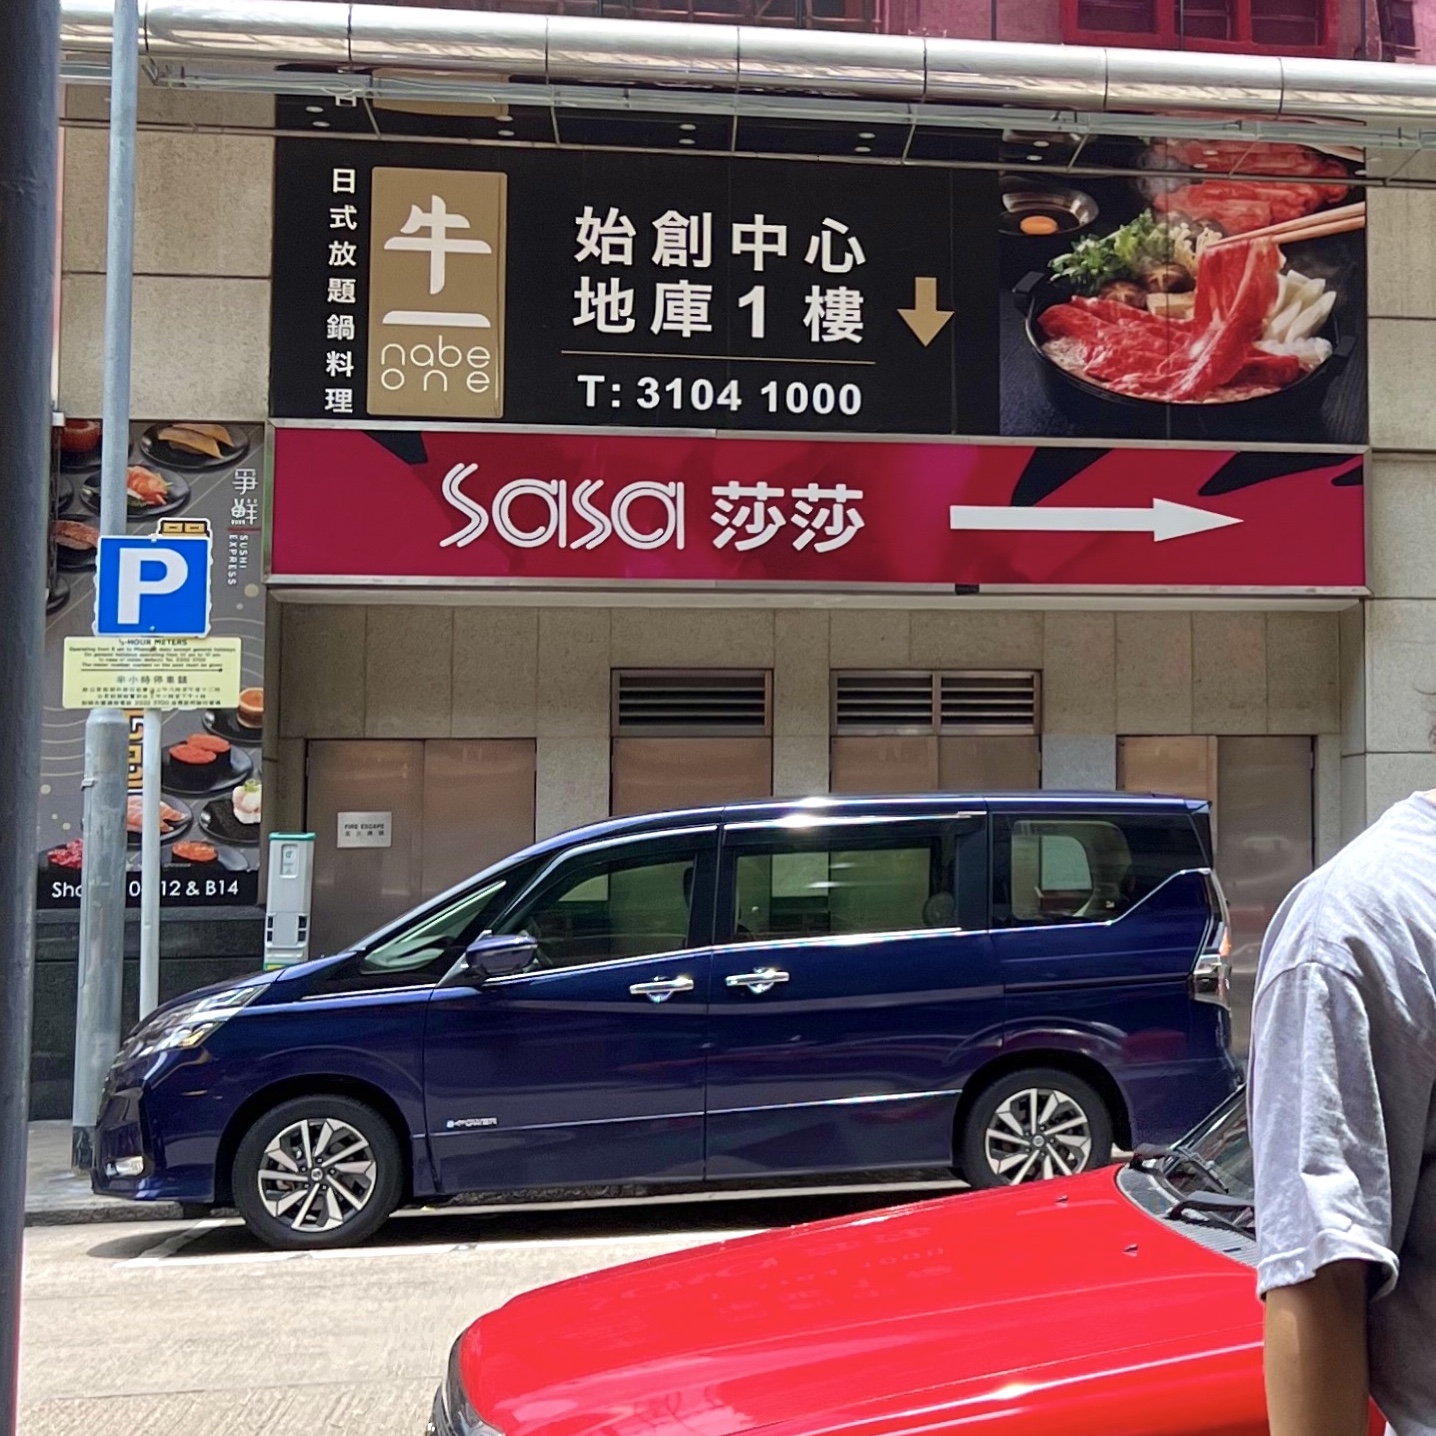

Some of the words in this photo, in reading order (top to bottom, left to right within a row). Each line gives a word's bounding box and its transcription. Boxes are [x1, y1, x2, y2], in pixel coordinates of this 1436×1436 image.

[574, 205, 866, 275] 始創中心
[324, 168, 358, 413] 日式放題鍋料理
[381, 335, 491, 368] nabe
[381, 368, 490, 393] one
[577, 374, 621, 408] T:
[636, 376, 742, 411] 3104
[761, 380, 862, 415] 1000
[710, 480, 865, 553] 莎莎
[227, 534, 239, 585] EXPRESS
[238, 534, 249, 569] SUSHI
[117, 547, 188, 624] P
[51, 881, 83, 899] Sho
[185, 880, 201, 897] &
[205, 879, 239, 896] B14
